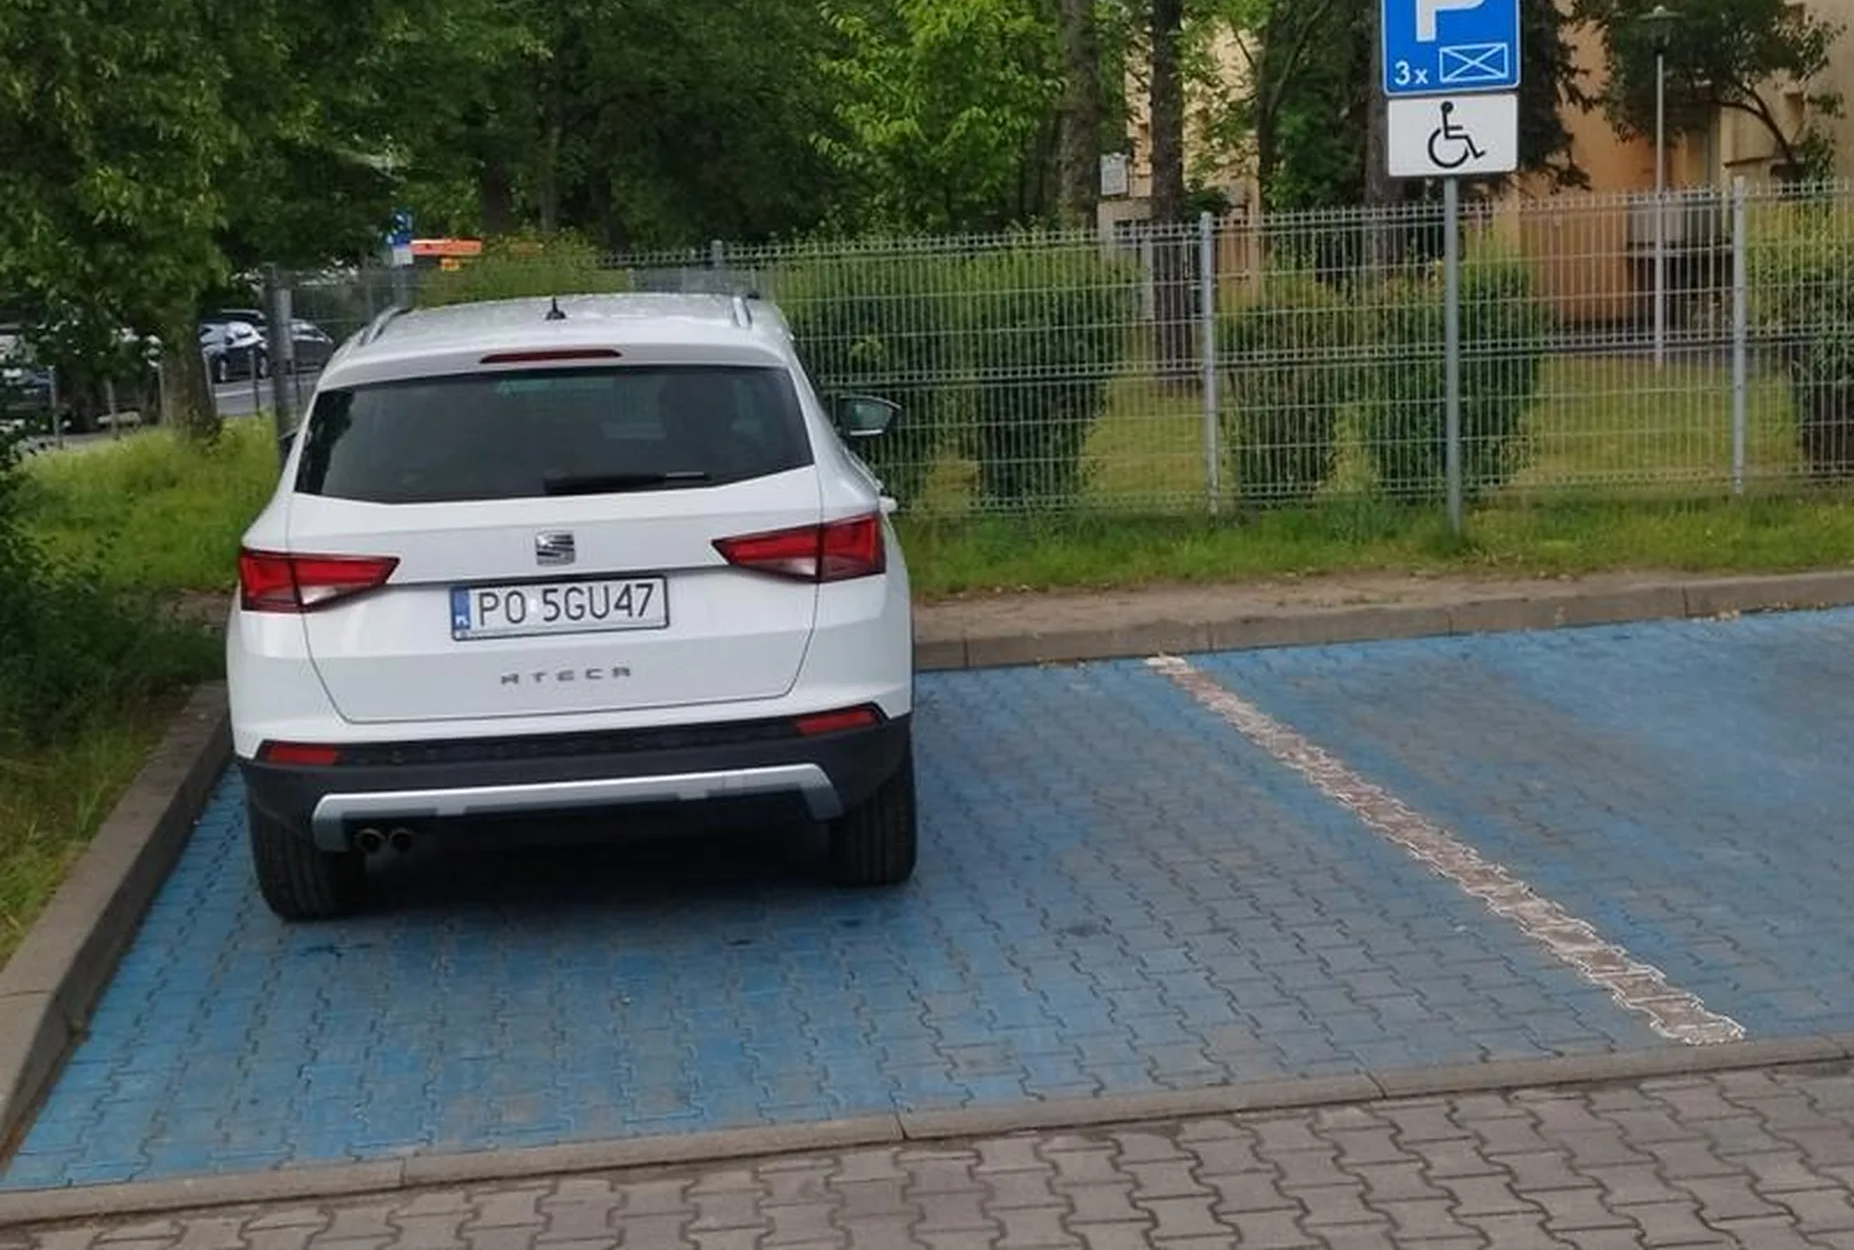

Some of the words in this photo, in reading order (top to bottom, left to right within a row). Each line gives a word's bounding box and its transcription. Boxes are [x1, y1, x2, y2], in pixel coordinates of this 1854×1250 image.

[478, 590, 526, 627] PO
[542, 583, 654, 622] 5GU47
[500, 667, 631, 684] ATECA
